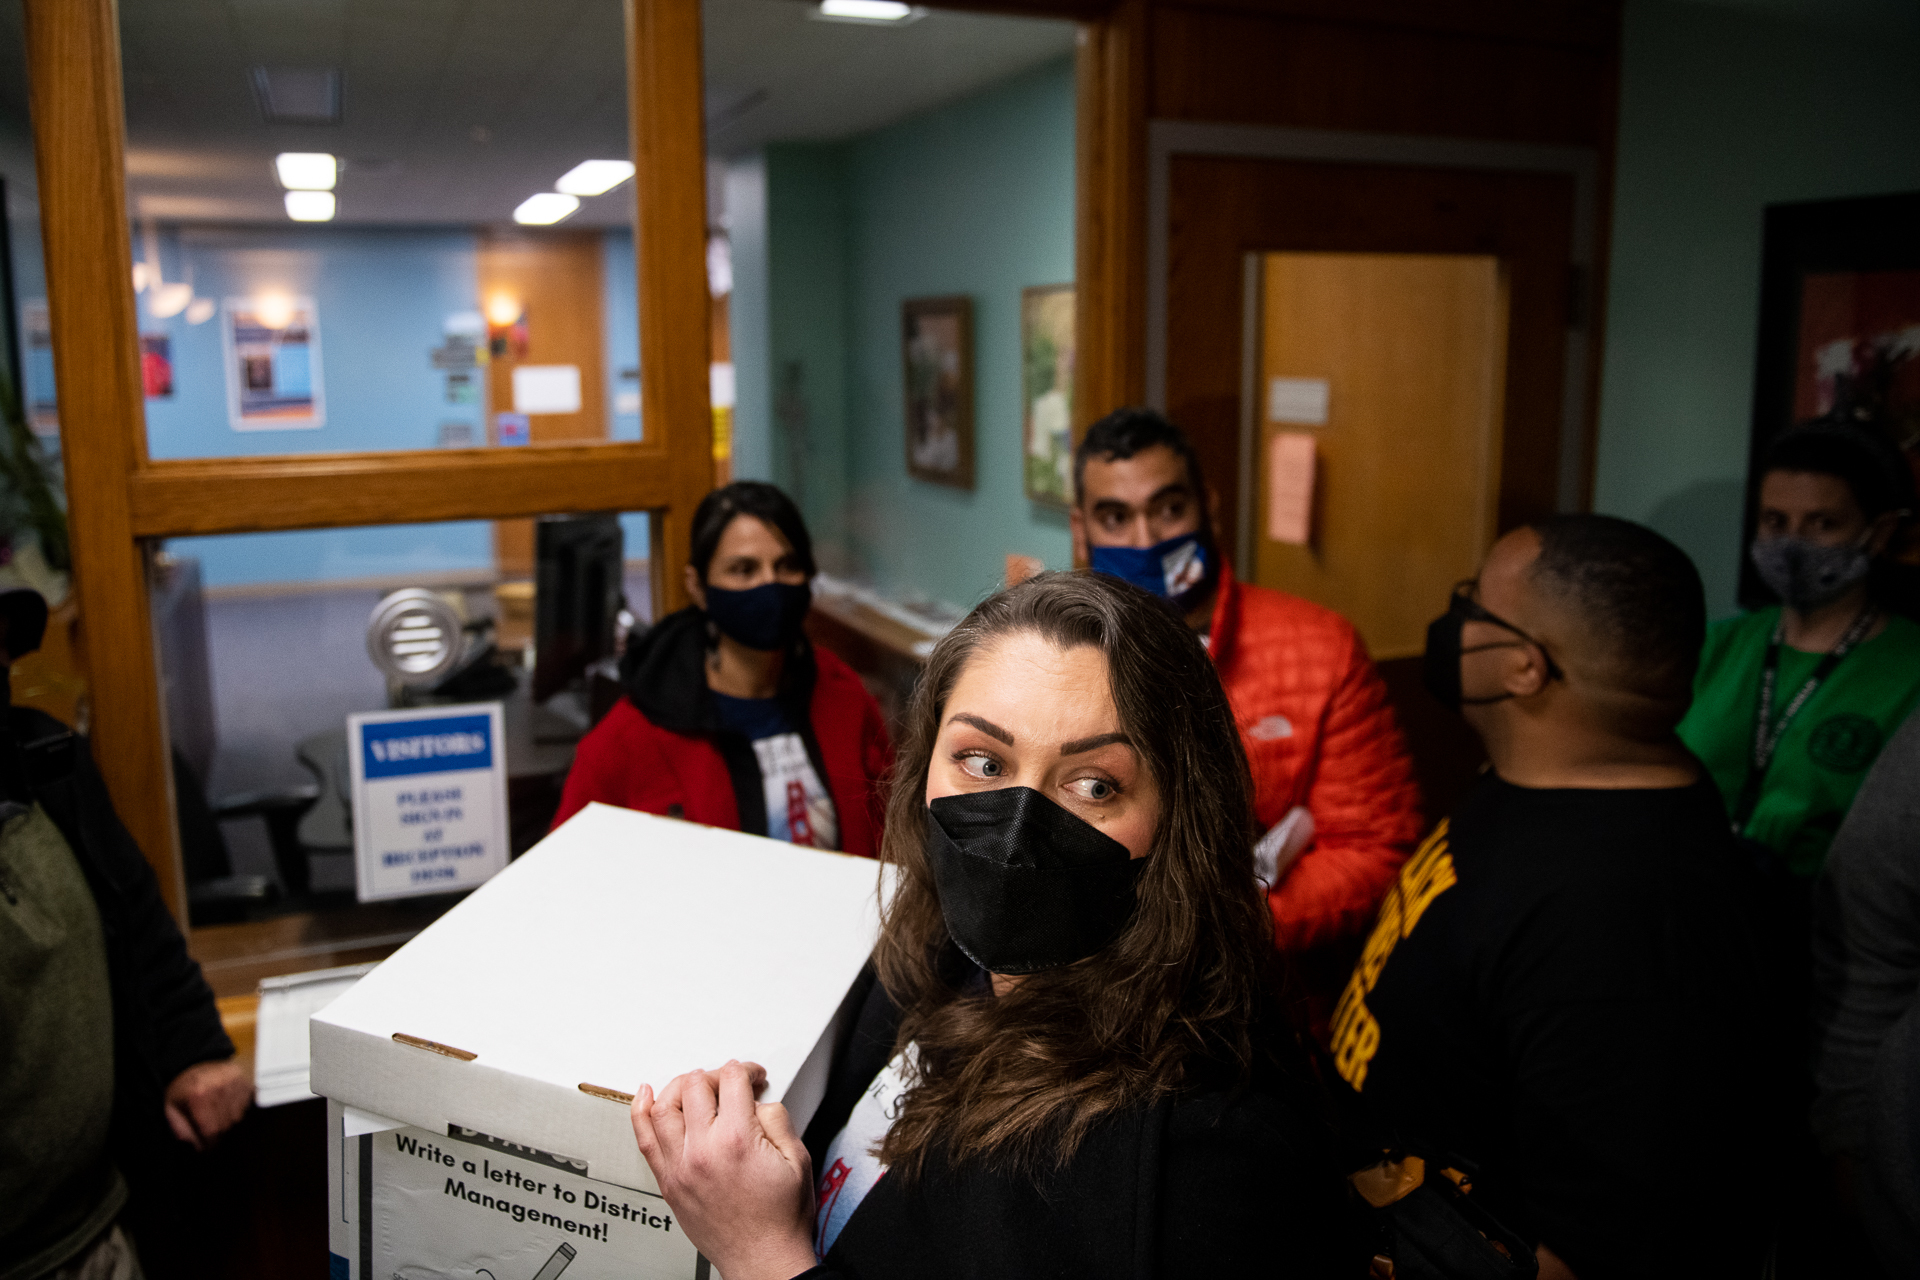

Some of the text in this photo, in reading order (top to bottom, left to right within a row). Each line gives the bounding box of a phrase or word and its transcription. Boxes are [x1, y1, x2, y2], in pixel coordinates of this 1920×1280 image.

[371, 732, 486, 762] VISITORS
[396, 788, 462, 806] PLEASE
[382, 843, 485, 867] RECEPTION
[395, 1132, 456, 1168] Write
[462, 1160, 476, 1175] a
[483, 1159, 548, 1198] letter
[553, 1183, 577, 1204] to
[584, 1190, 672, 1233] District
[444, 1177, 609, 1243] Management!
